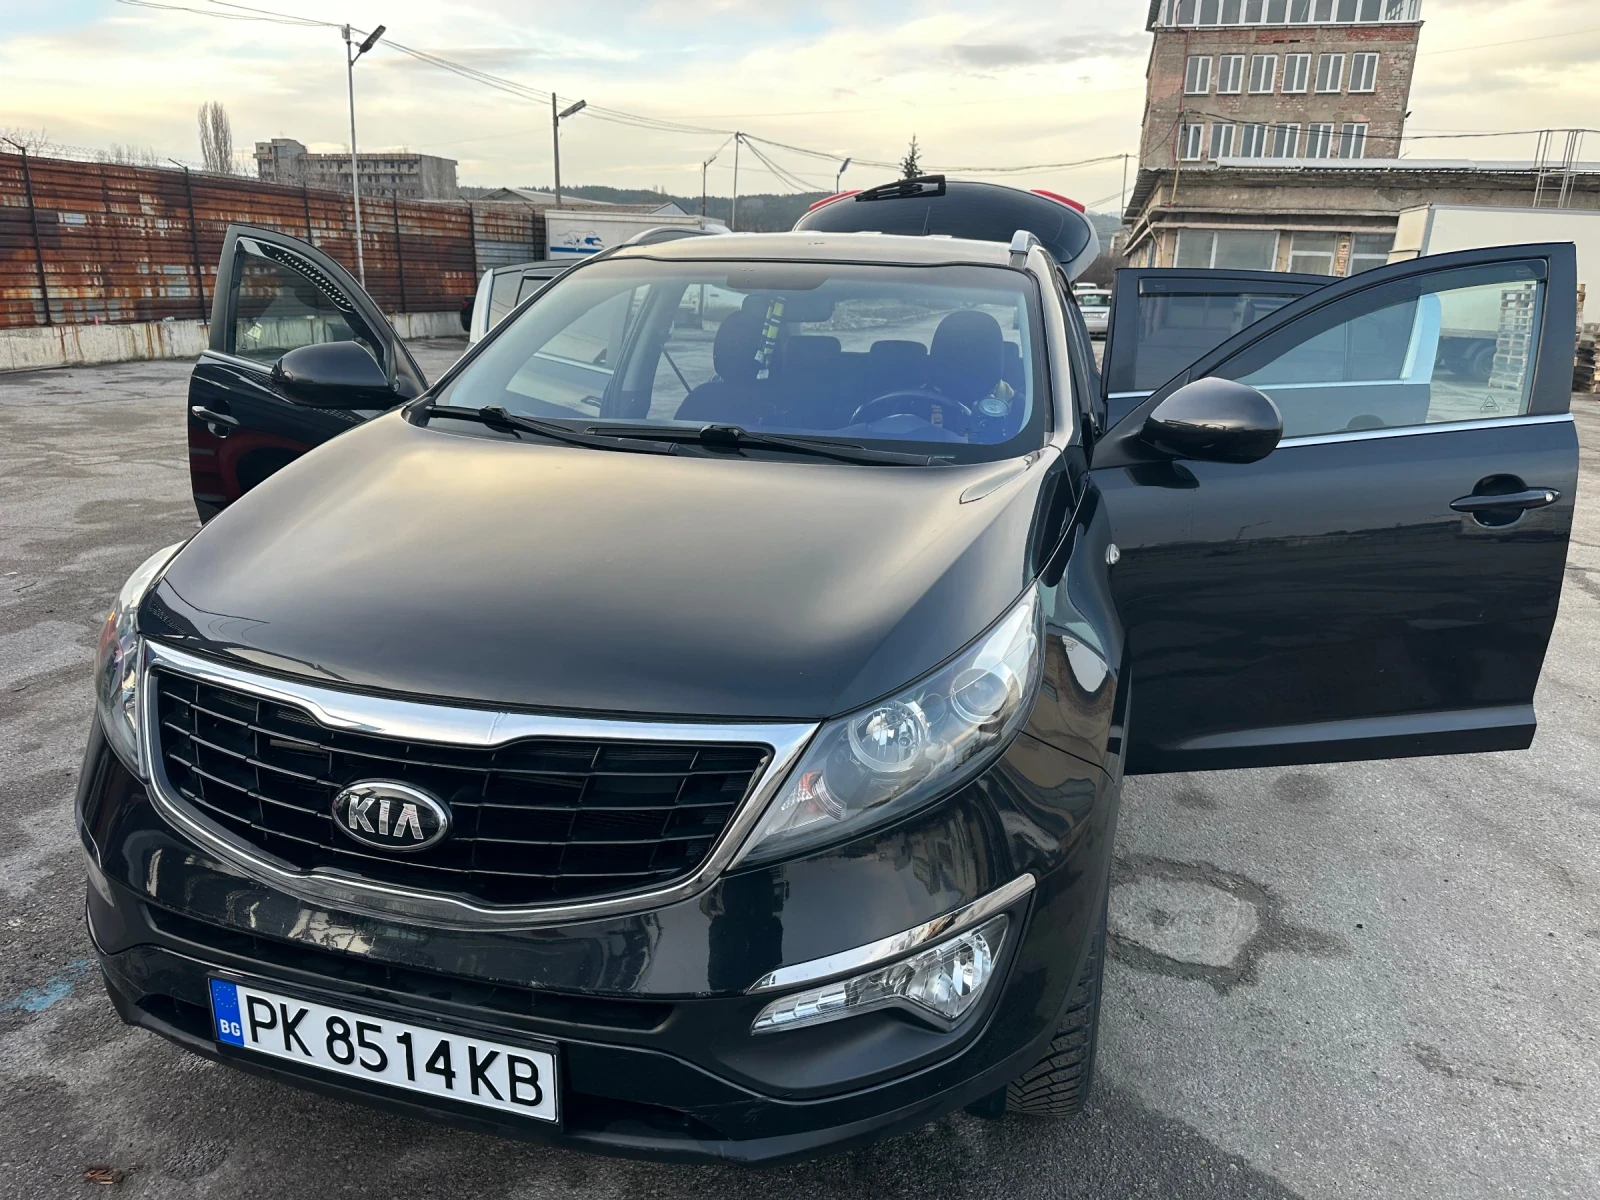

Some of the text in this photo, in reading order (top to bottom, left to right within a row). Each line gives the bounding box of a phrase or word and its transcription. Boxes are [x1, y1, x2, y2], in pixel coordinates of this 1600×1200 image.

[349, 795, 424, 840] KIA
[220, 1018, 240, 1037] BG
[245, 994, 313, 1057] PK
